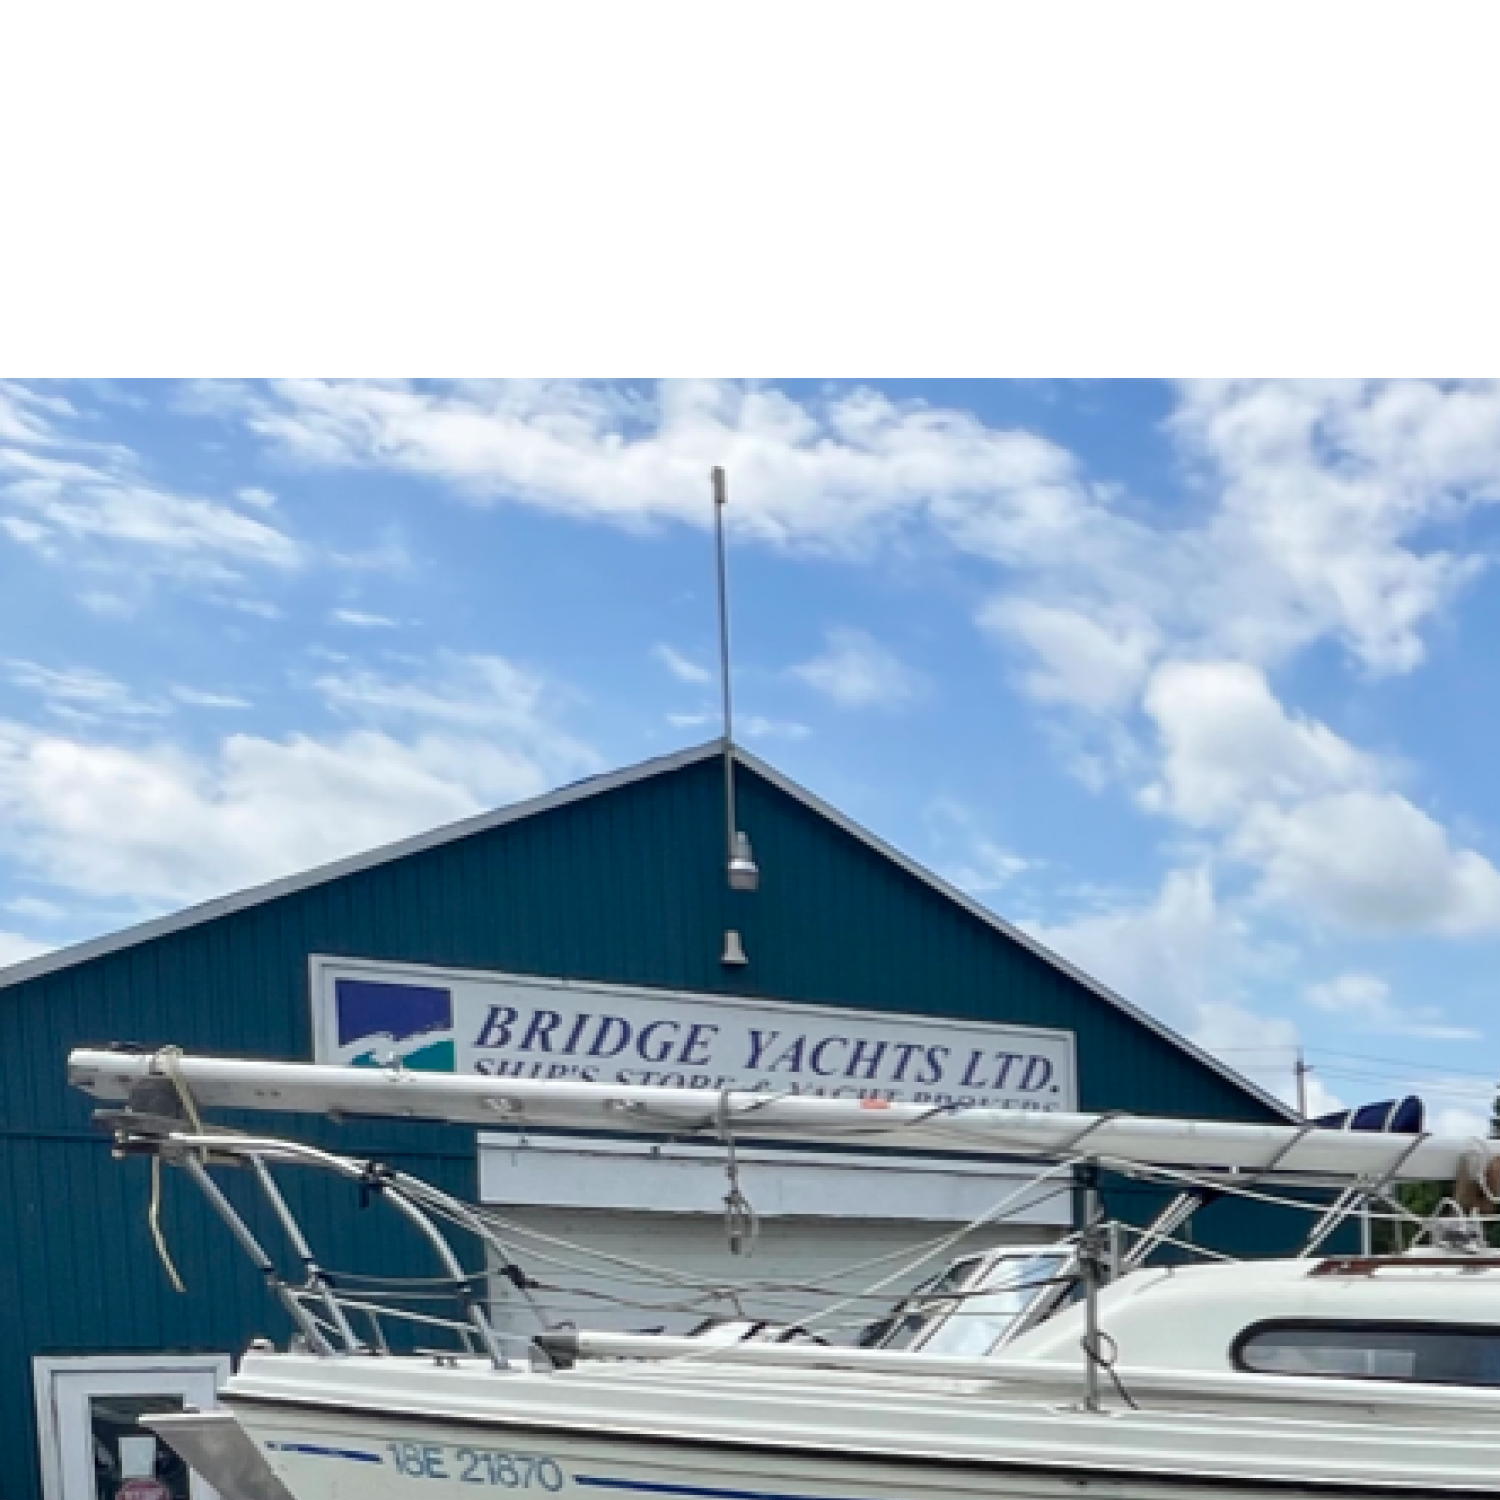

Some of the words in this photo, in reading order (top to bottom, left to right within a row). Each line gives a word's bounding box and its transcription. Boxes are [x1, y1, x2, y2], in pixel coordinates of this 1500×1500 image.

[472, 1004, 719, 1066] BRIDGE
[743, 1028, 951, 1084] YACHTS
[958, 1050, 1060, 1093] LTD.
[386, 1443, 450, 1479] 18E
[455, 1447, 564, 1492] 21870
